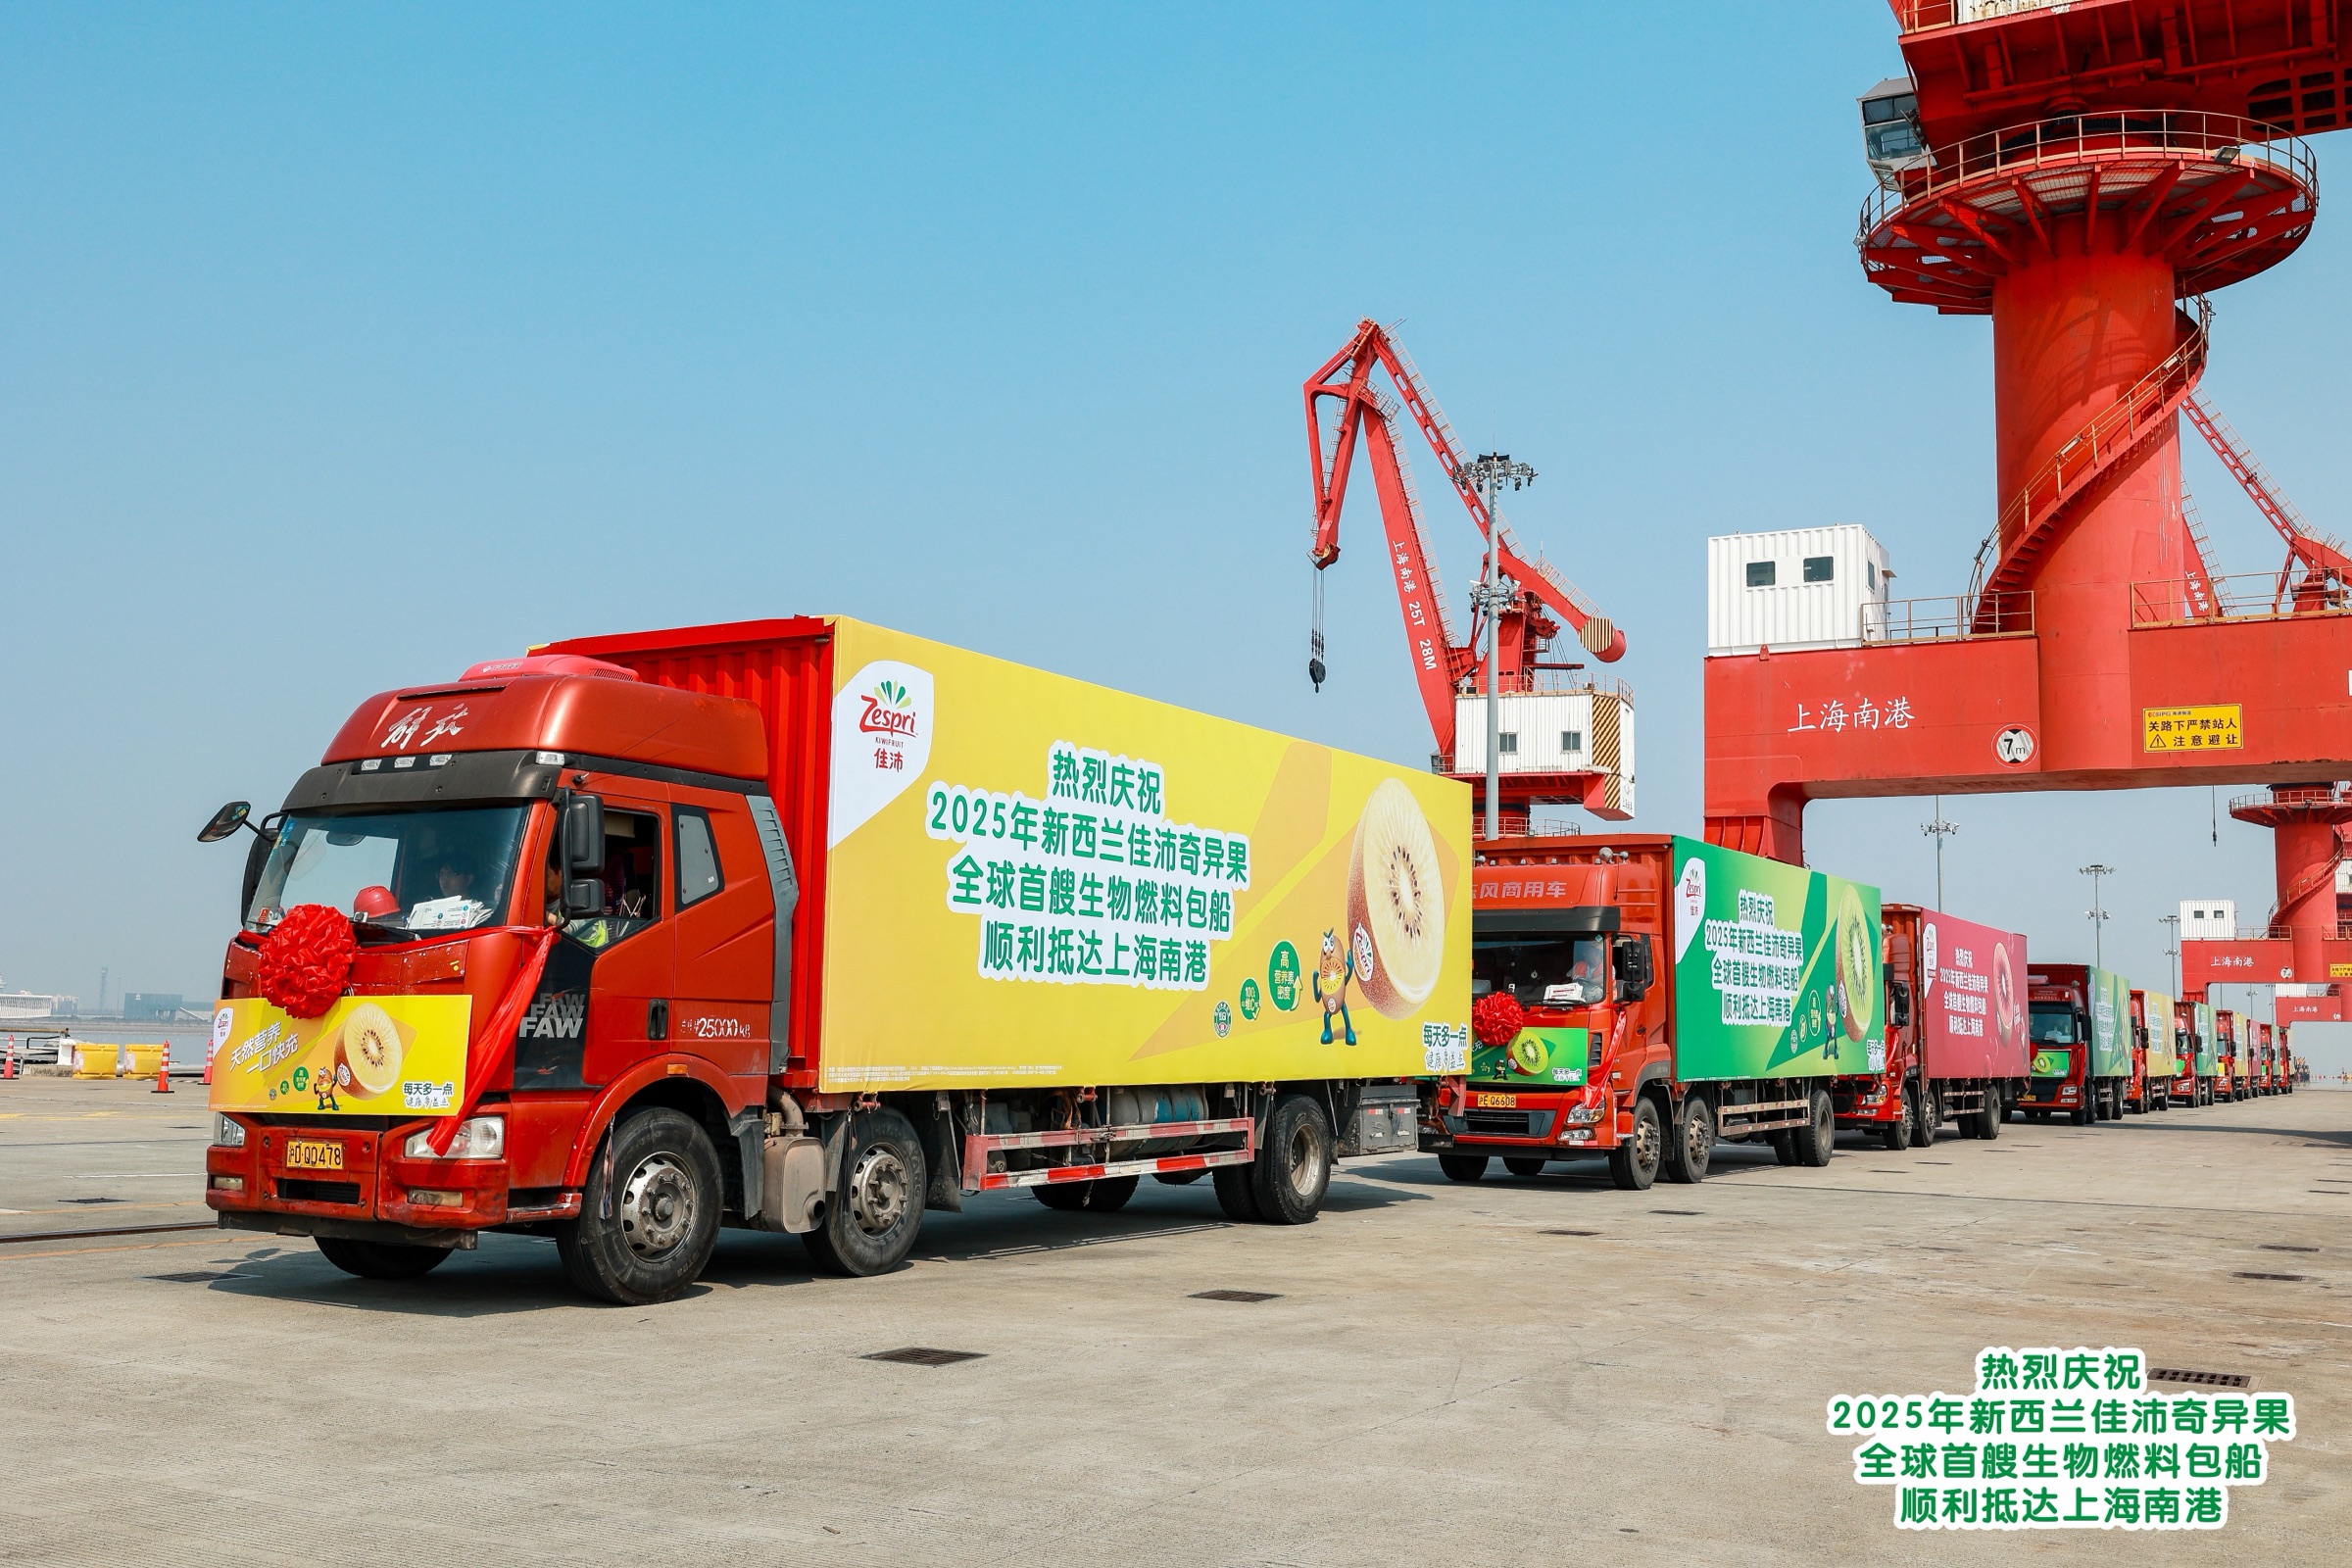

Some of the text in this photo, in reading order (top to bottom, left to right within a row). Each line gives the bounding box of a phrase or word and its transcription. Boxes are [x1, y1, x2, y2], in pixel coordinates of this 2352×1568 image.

[1393, 540, 1437, 670] 上海南港 25T 28M
[859, 695, 917, 738] Zespri
[1788, 697, 1916, 733] 上海南港
[875, 737, 905, 748] KIWIFRUIT
[2173, 733, 2238, 747] 注意避让
[874, 748, 904, 772] 佳沛
[1053, 748, 1162, 814] 热烈庆祝
[932, 790, 1249, 884] 2025年新西兰佳沛奇异果
[952, 855, 1232, 934] 全球首艘生物燃料包船
[1740, 895, 1774, 926] 热烈庆祝
[984, 926, 1208, 983] 顺利抵达上海南港
[1706, 924, 1803, 962] 2025年新西兰佳沛奇异果
[1713, 957, 1798, 992] 全球首艘生物燃料包船
[2211, 956, 2254, 967] 上海南港
[1723, 992, 1791, 1022] 顺利抵达上海南港
[518, 1017, 584, 1039] FAW
[1423, 1024, 1468, 1048] 每天多一点
[229, 1021, 281, 1072] 天然营养
[246, 1033, 299, 1074] 一口快充
[404, 1082, 454, 1096] 每天多一点
